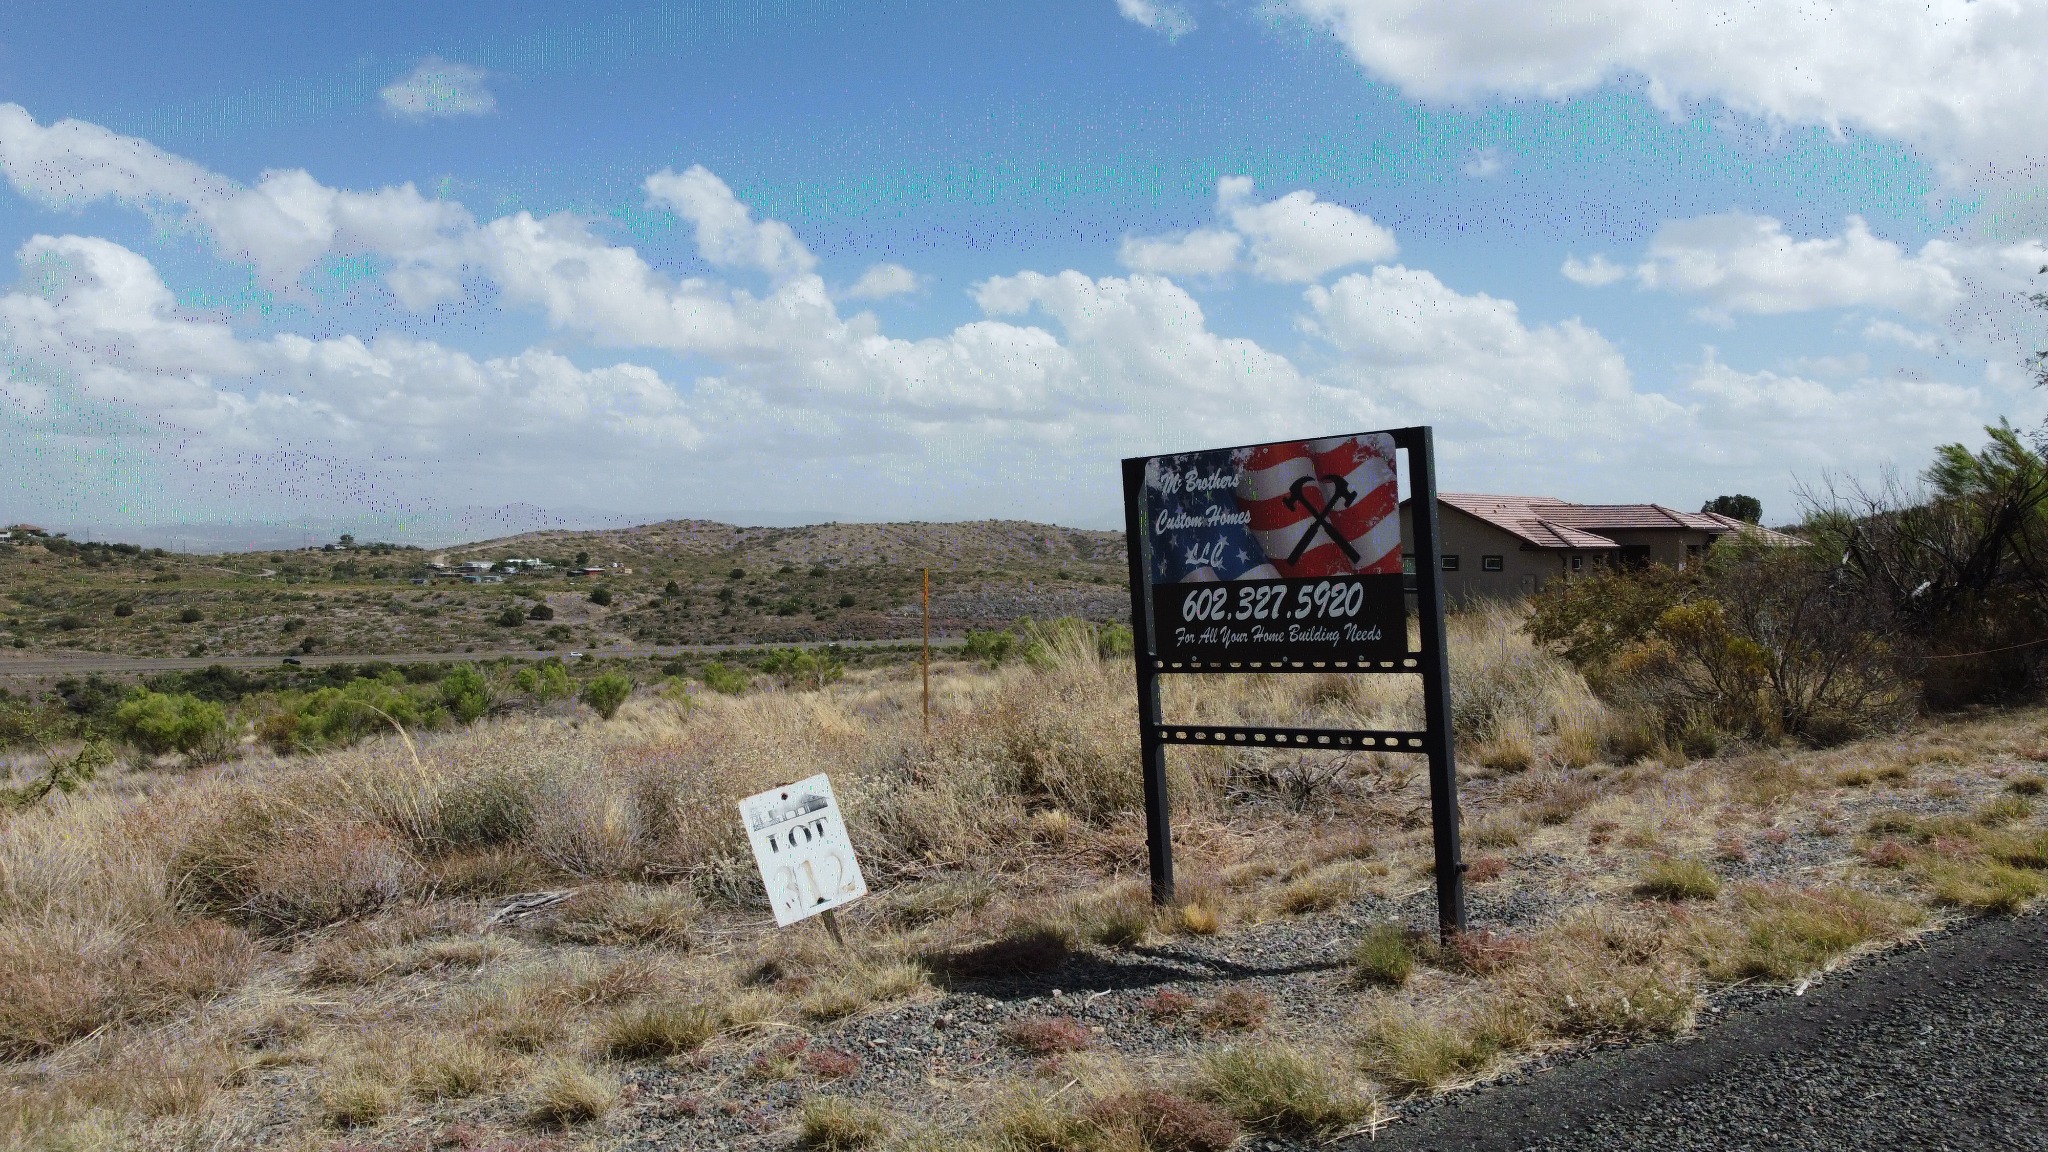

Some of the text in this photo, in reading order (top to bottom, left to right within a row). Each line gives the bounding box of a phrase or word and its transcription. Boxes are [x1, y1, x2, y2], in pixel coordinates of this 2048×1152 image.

[1185, 467, 1240, 492] Brothers
[1155, 505, 1252, 535] Custom Homes
[1185, 541, 1224, 568] LLC
[1182, 581, 1364, 622] 602.327.5920
[1175, 622, 1383, 649] For All Your Home Building Needs
